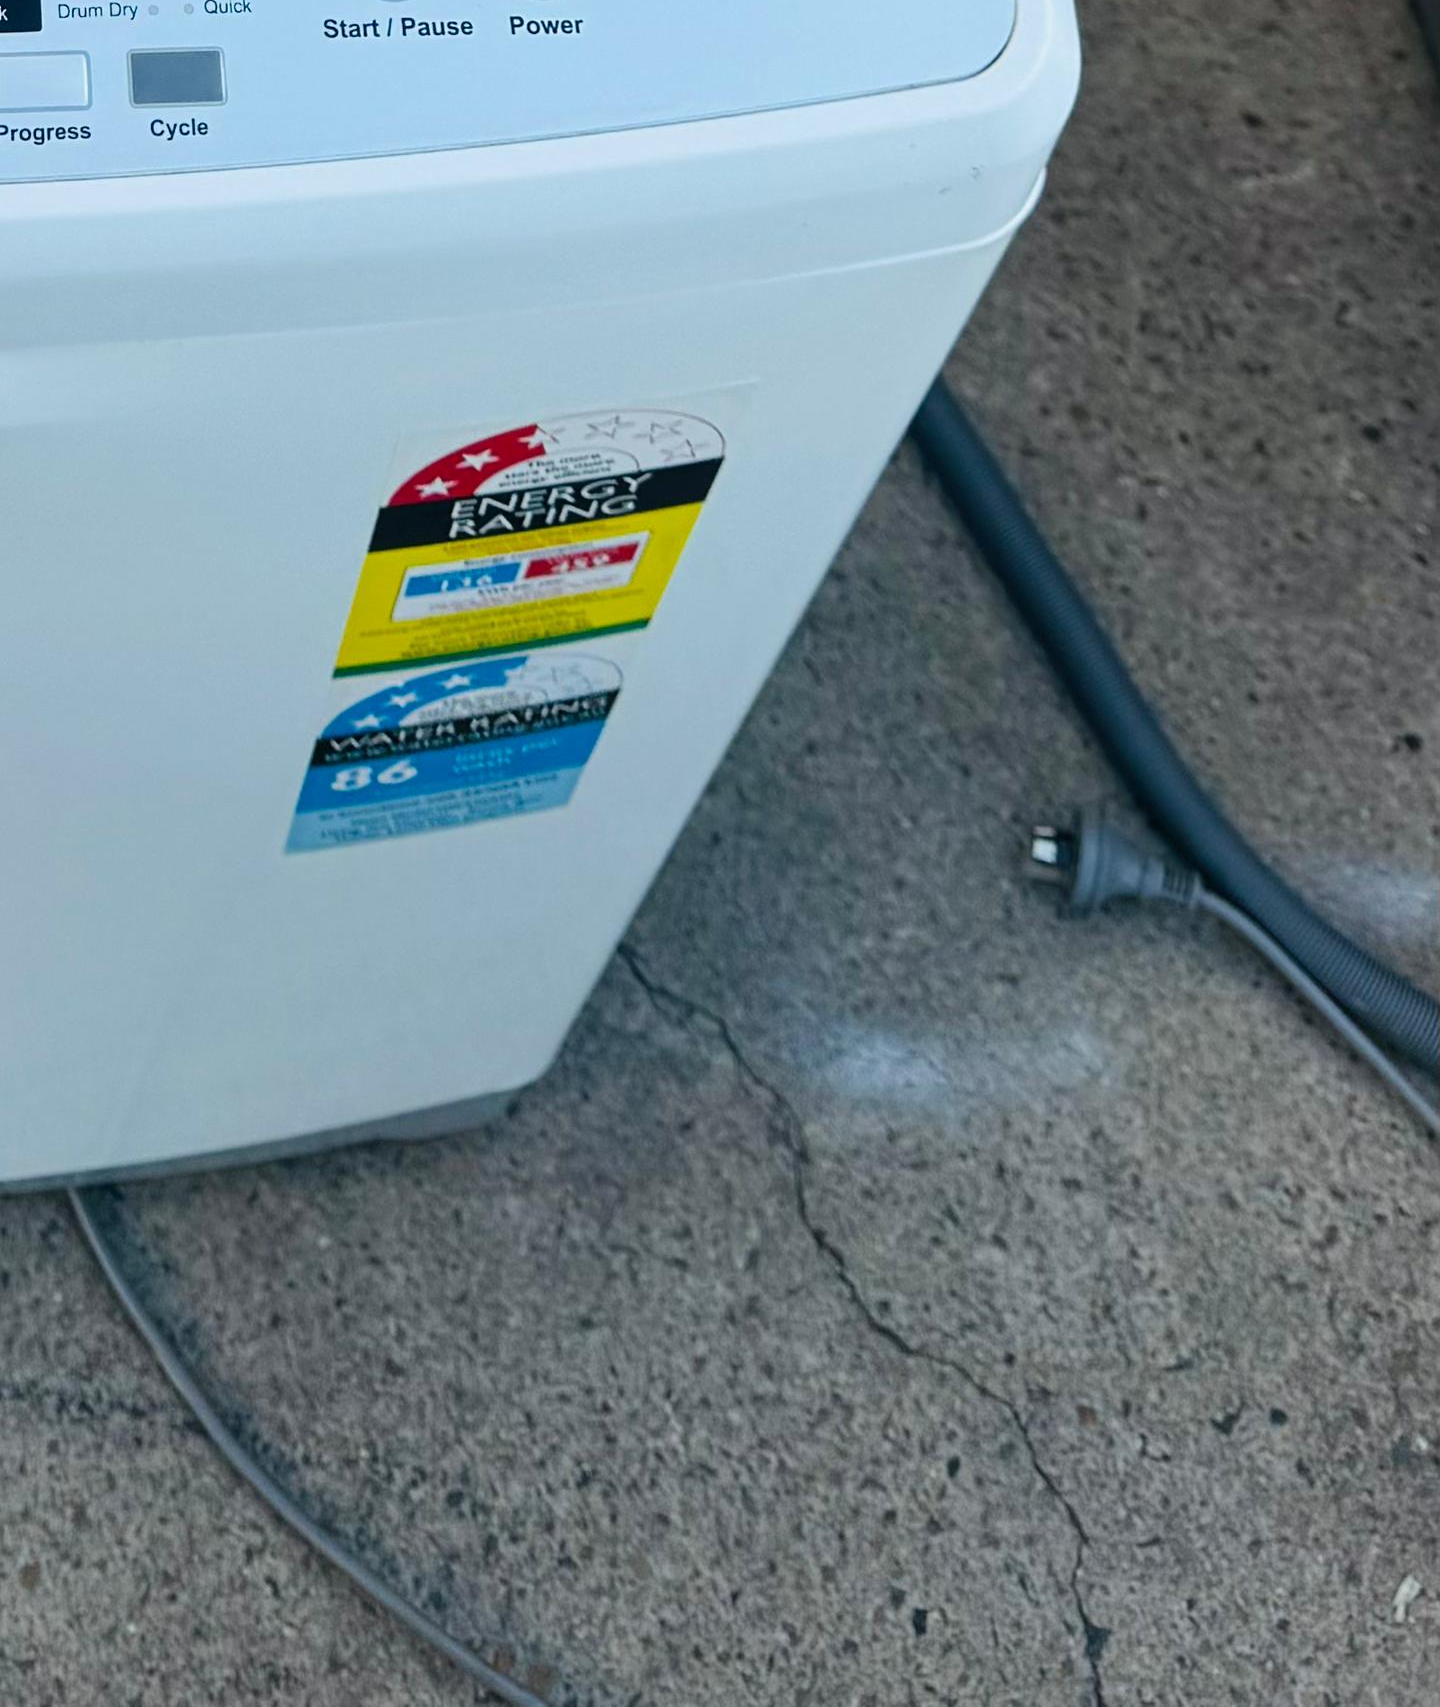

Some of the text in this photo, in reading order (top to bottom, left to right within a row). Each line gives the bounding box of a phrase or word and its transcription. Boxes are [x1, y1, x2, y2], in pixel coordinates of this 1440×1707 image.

[57, 2, 138, 21] Drum Dry
[323, 18, 381, 39] Start
[400, 17, 474, 37] Pause
[509, 15, 584, 36] Power
[150, 117, 209, 141] Cycle
[449, 472, 653, 520] ENERGY
[448, 494, 638, 540] RATING
[330, 759, 418, 792] 86
